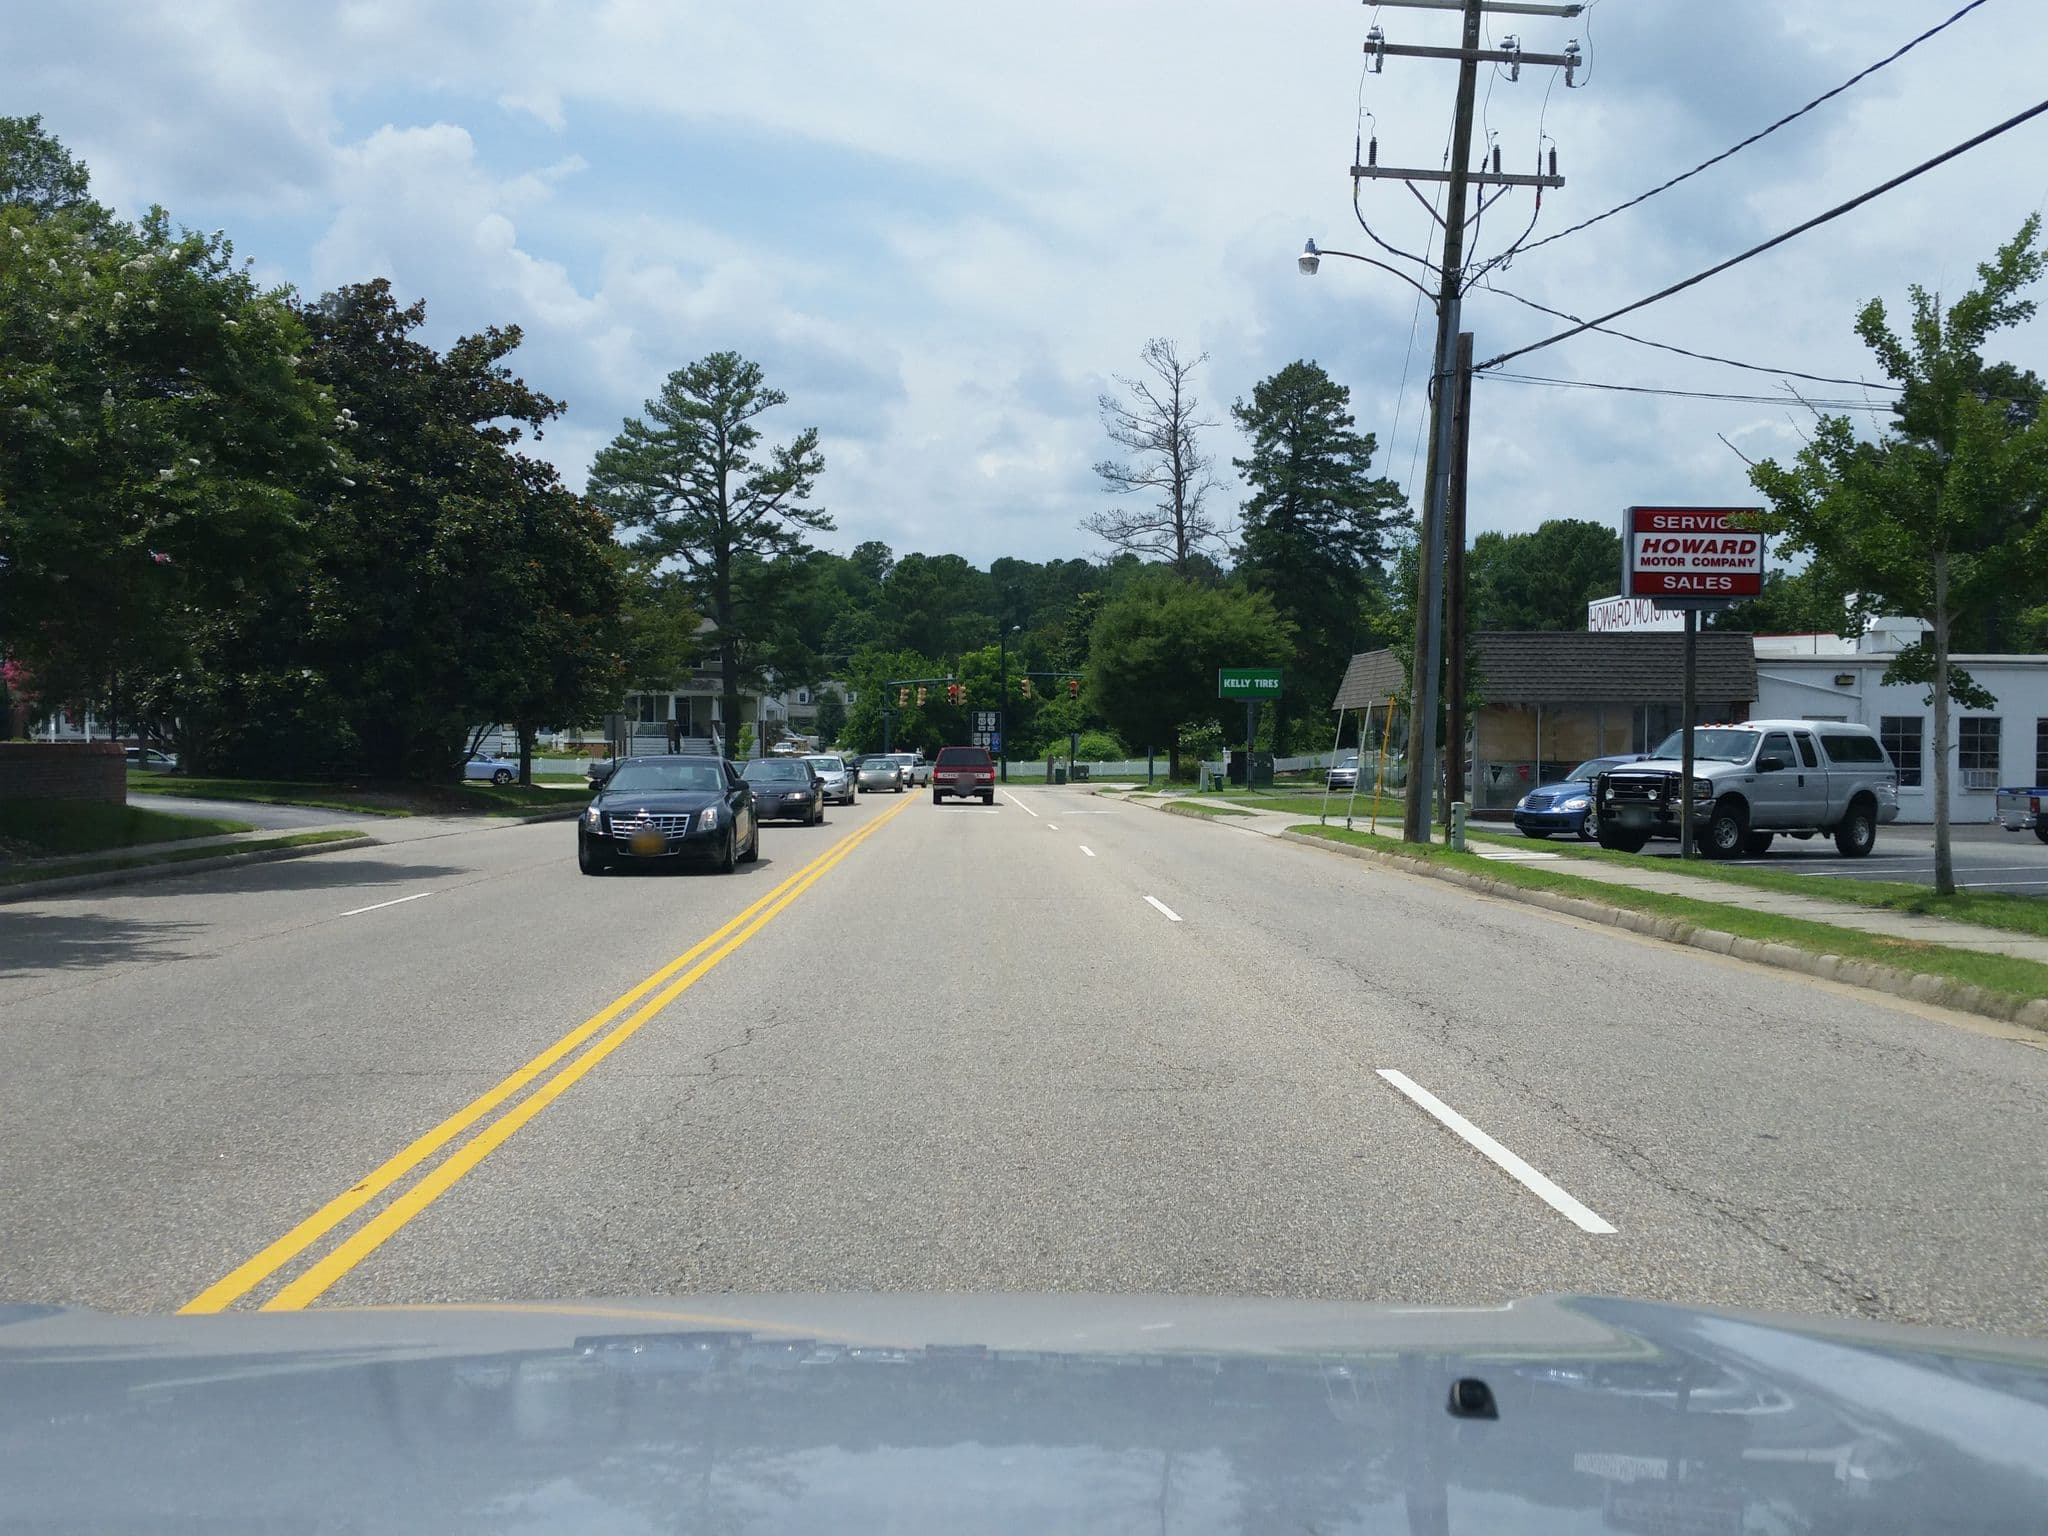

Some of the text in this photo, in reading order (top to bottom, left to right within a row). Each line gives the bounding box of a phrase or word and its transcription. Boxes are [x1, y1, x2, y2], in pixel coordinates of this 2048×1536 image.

[1653, 515, 1746, 530] SERVIC
[1642, 538, 1757, 555] HOWARD
[1640, 557, 1756, 568] MOTOR COMPANY
[1663, 575, 1733, 590] SALES
[1589, 600, 1632, 631] HOWARD
[1224, 679, 1278, 688] KELLY TIRES
